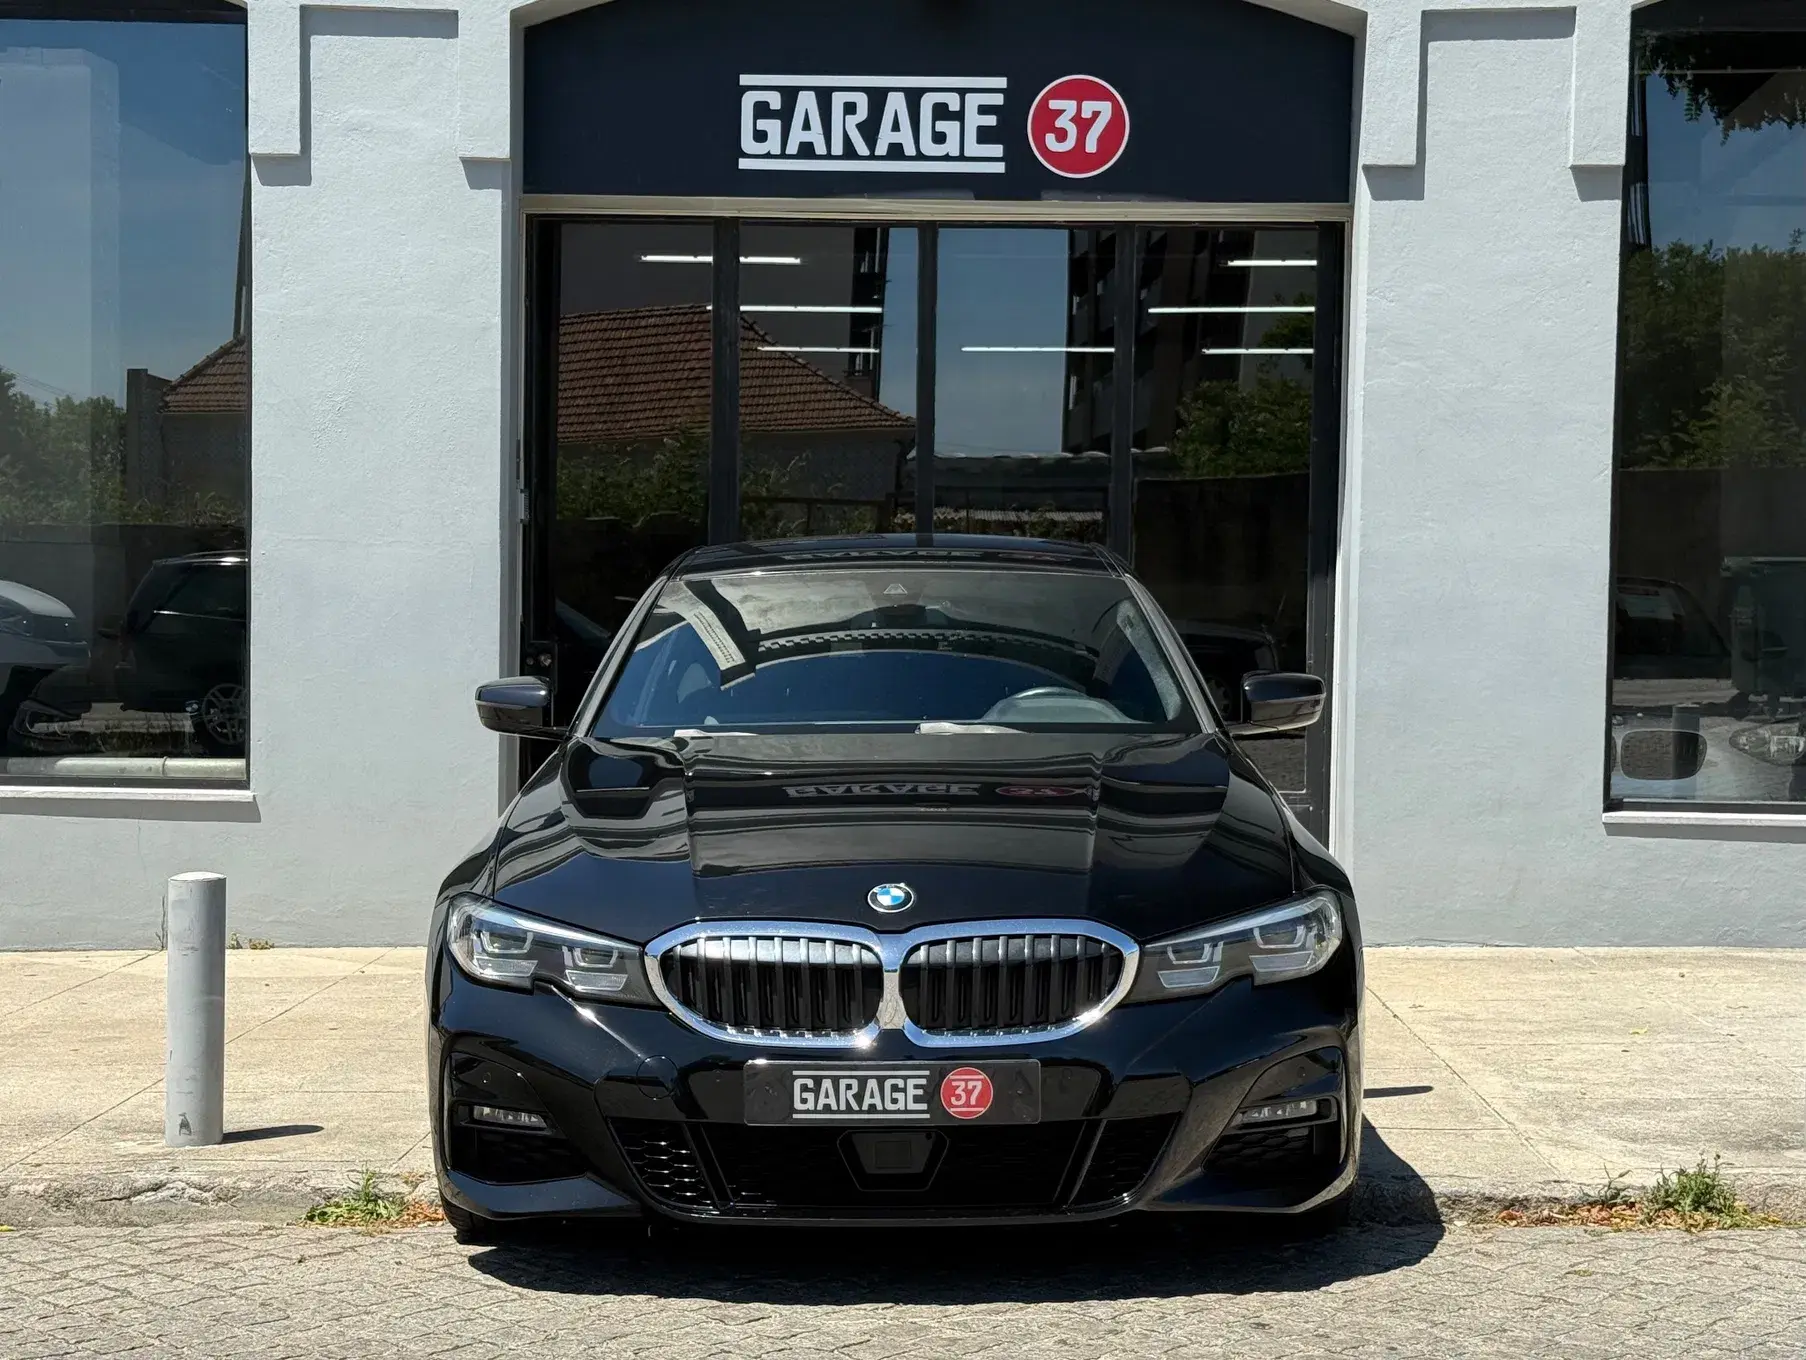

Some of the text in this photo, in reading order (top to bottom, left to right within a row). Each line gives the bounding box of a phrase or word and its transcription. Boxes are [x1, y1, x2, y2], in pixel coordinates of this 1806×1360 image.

[740, 90, 1113, 157] GARAGE 37
[793, 1078, 983, 1111] GARAGE 37
